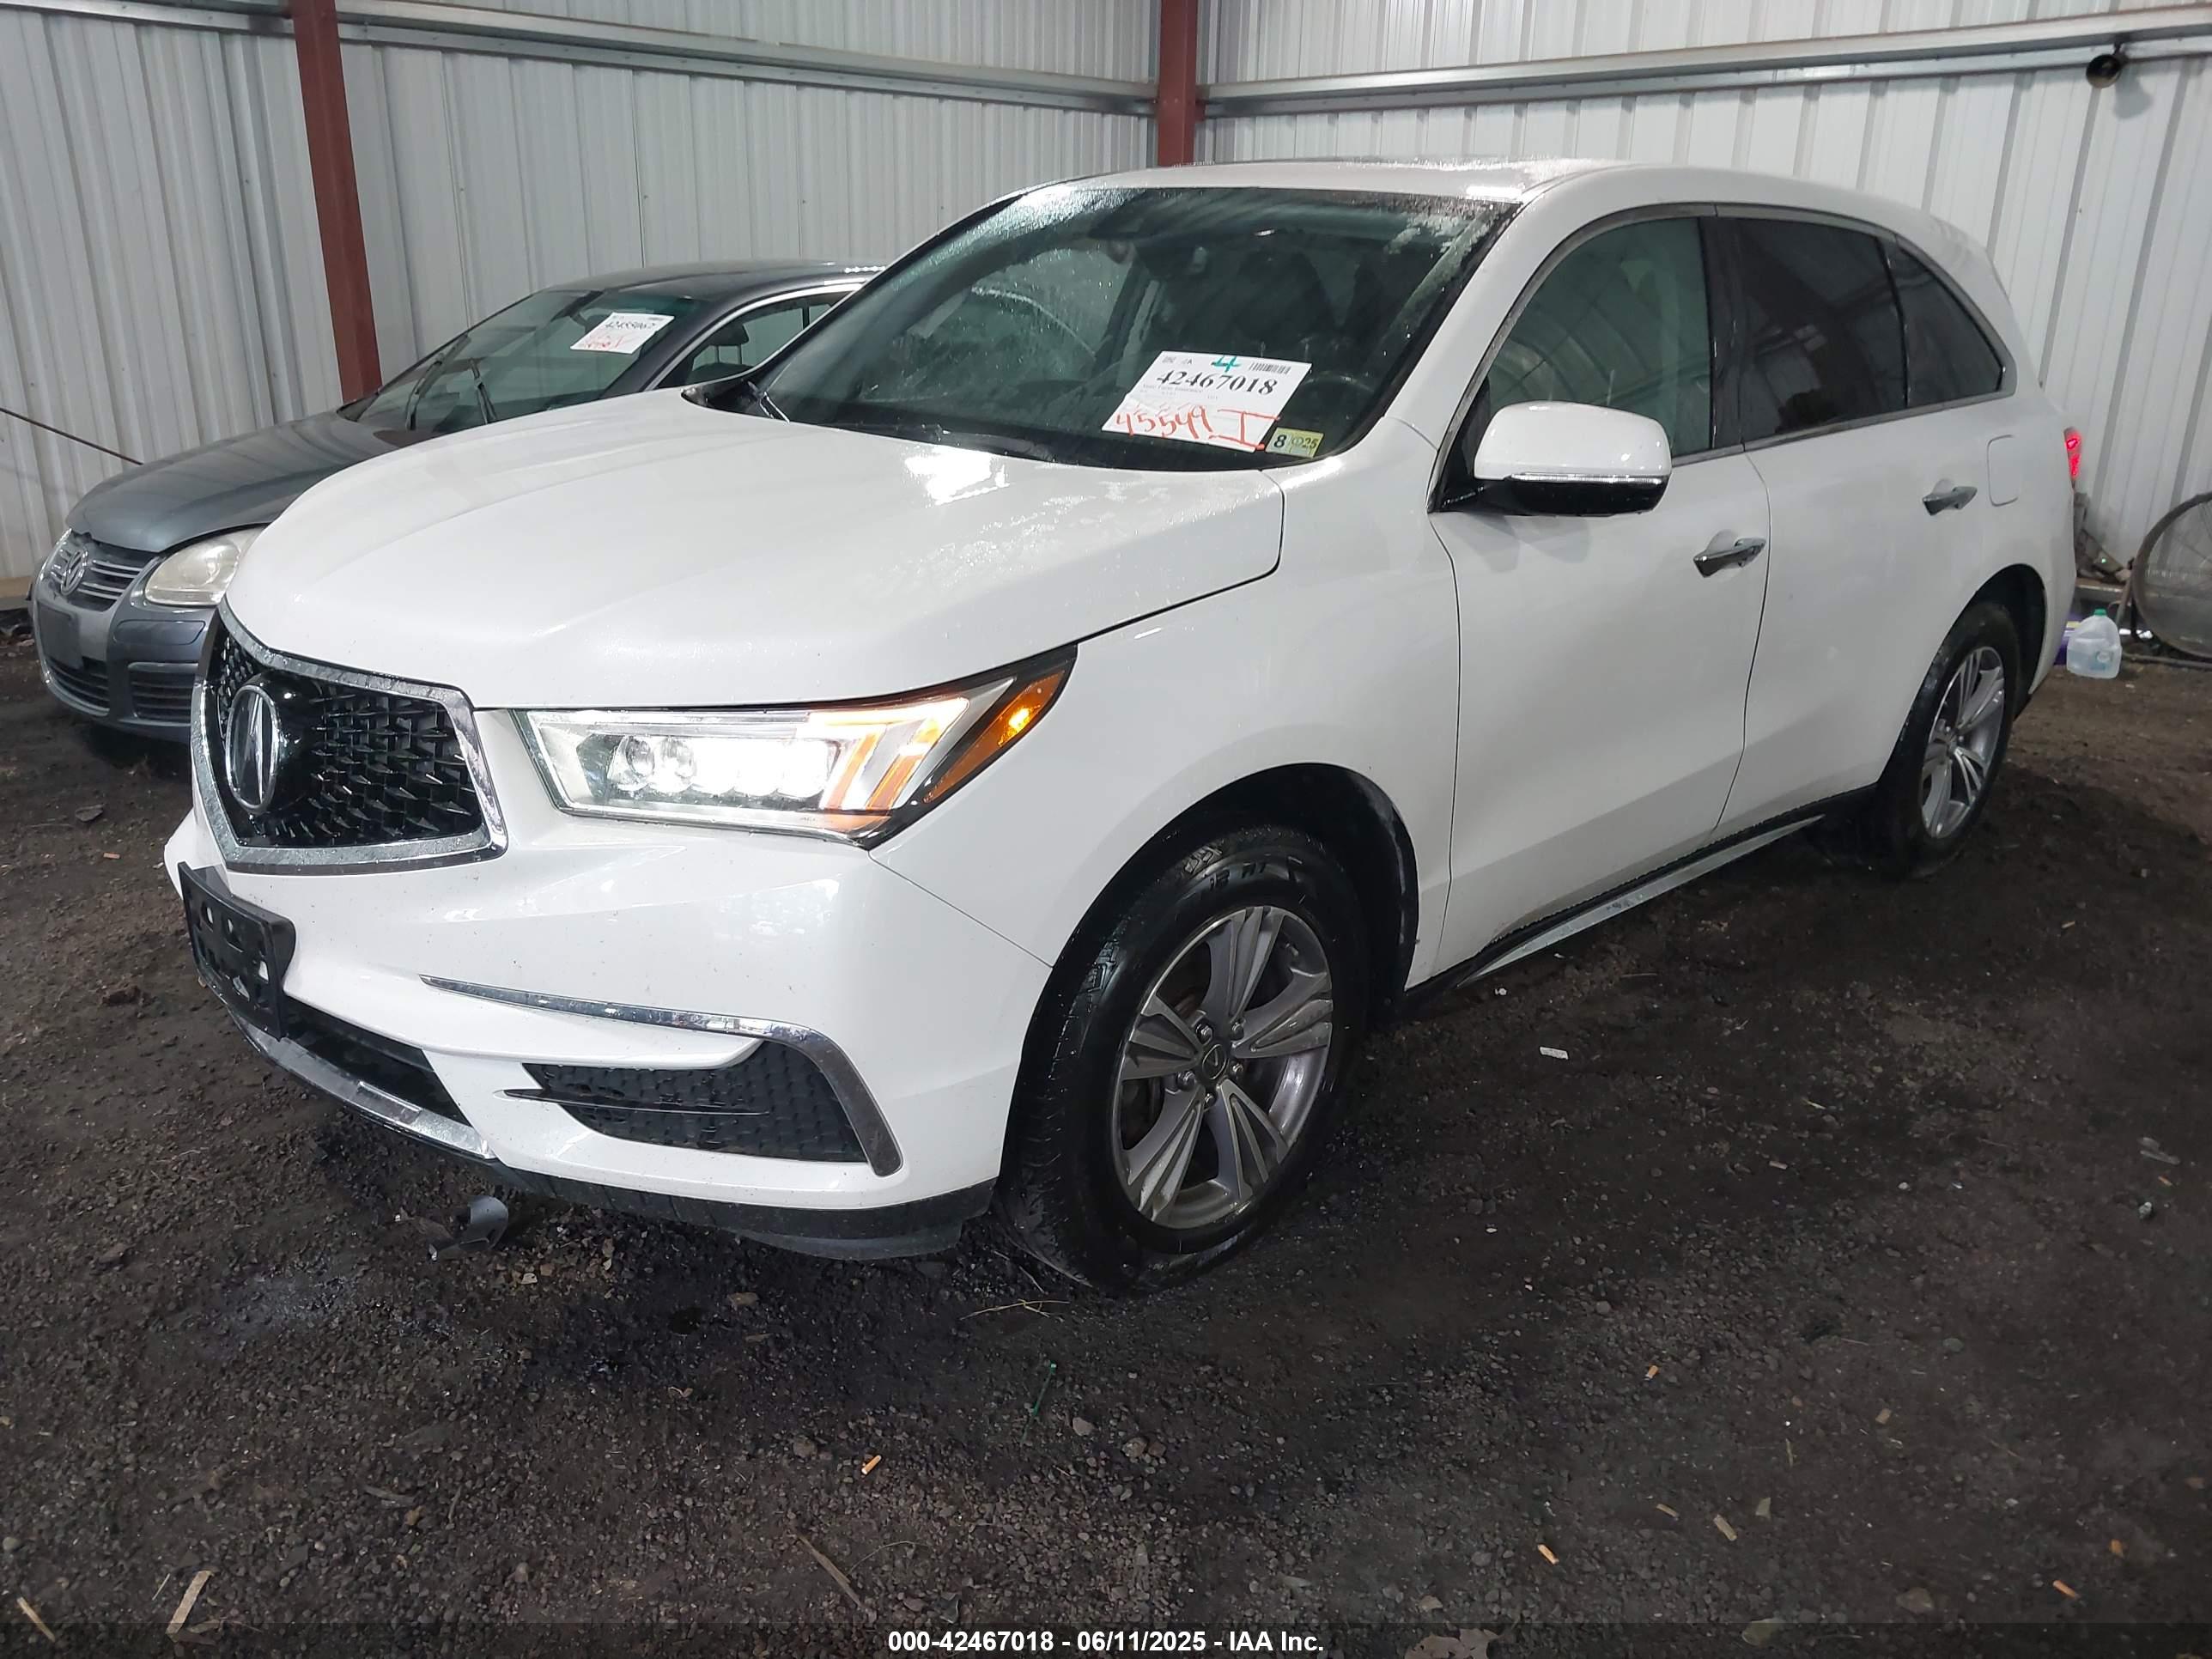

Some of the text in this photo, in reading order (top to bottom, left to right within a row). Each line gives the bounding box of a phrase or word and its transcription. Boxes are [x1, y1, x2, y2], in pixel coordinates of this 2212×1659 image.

[1211, 355, 1242, 373] 4
[1156, 369, 1278, 396] 42467018
[1273, 434, 1286, 447] 8
